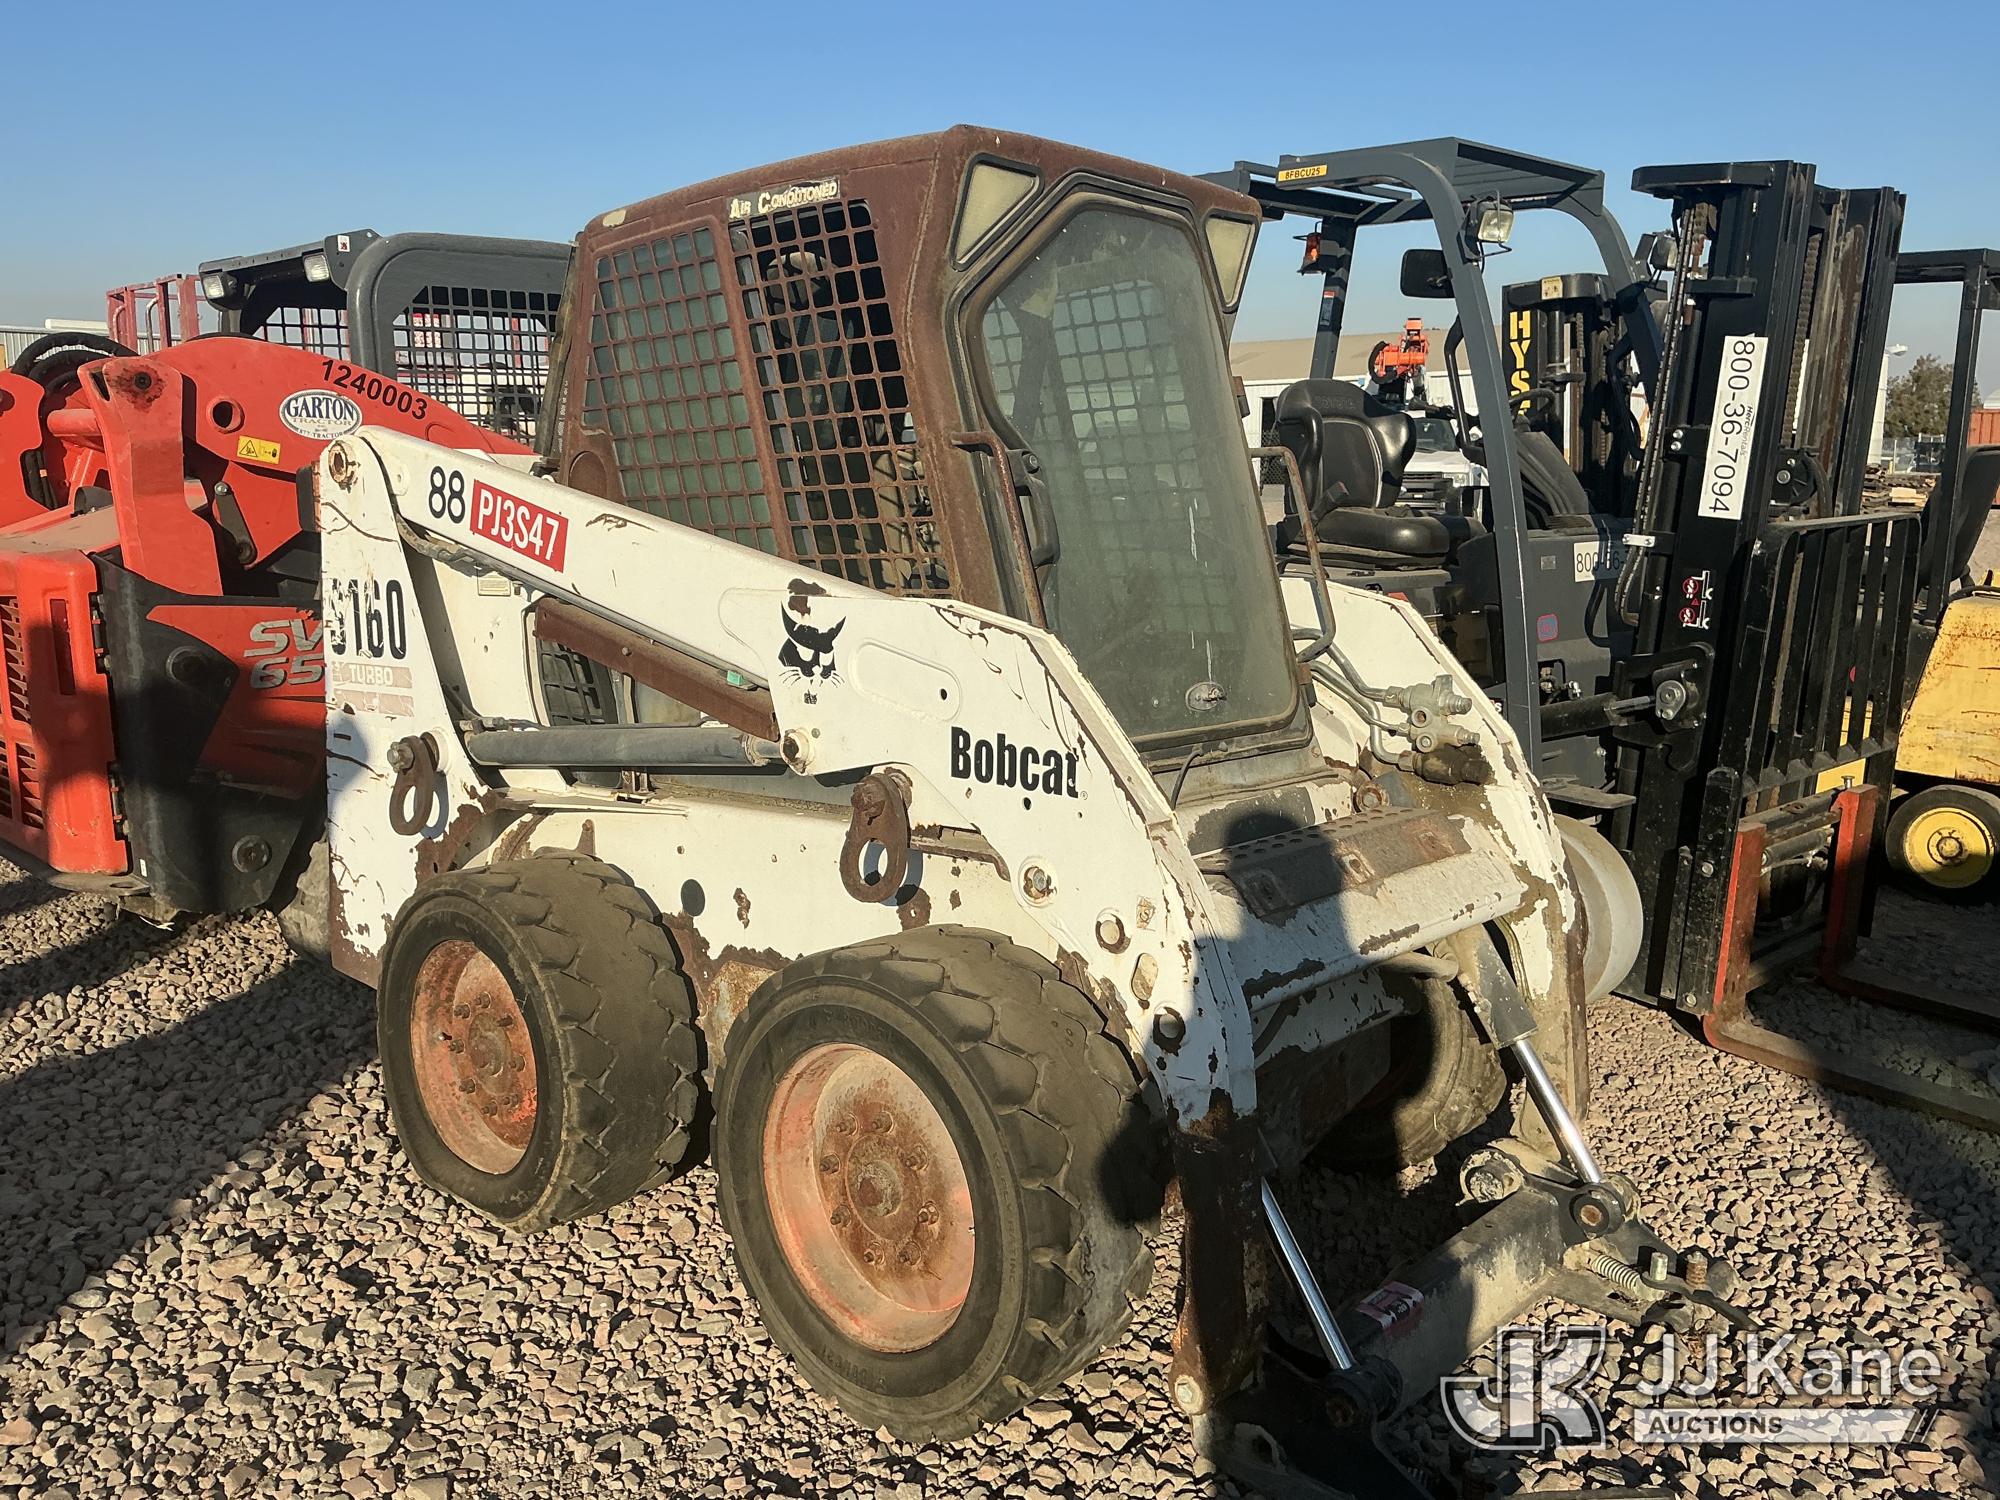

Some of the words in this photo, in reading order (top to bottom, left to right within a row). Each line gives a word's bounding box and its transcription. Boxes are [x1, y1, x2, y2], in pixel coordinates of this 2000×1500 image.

[1285, 167, 1321, 180] 8FBCU25
[286, 395, 354, 421] GARTON
[322, 359, 428, 420] 1240003
[292, 418, 352, 426] TRACTOR
[1709, 340, 1756, 513] 800-36-7094
[428, 465, 466, 524] 88
[477, 488, 560, 561] PJ3S47
[349, 664, 394, 686] TURBO
[951, 726, 1079, 799] Bobcat
